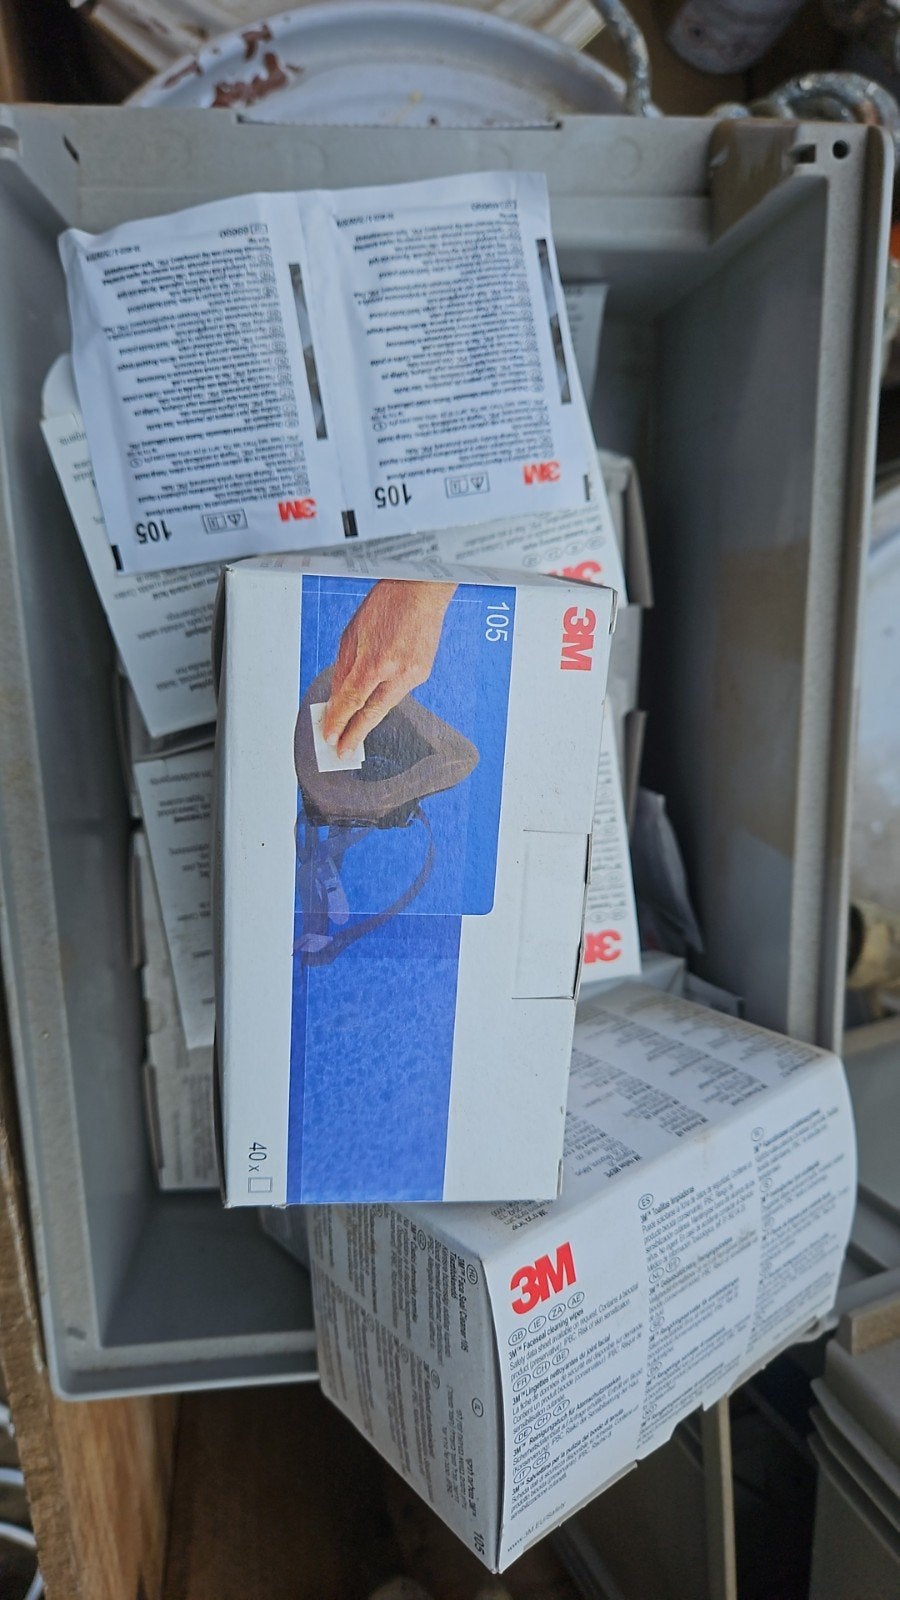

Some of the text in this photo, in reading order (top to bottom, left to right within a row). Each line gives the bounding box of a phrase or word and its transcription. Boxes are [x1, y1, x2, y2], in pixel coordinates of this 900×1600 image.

[522, 461, 561, 485] 3M
[375, 483, 412, 508] 105
[278, 498, 317, 522] 3M
[136, 519, 172, 544] 105
[485, 602, 510, 642] 105
[560, 606, 596, 671] 3M
[249, 1142, 267, 1161] 40
[458, 1274, 466, 1295] Face
[510, 1241, 576, 1315] 3M
[459, 1292, 467, 1312] Seal
[522, 1329, 546, 1351] Faceseal
[546, 1315, 568, 1337] cleaning
[569, 1306, 584, 1322] wipes
[509, 1354, 525, 1371] Safety
[526, 1346, 537, 1360] data
[537, 1337, 551, 1352] sheet
[552, 1324, 572, 1342] available
[510, 1363, 529, 1382] product
[525, 1374, 549, 1398] Lingettes
[474, 1531, 485, 1556] 105
